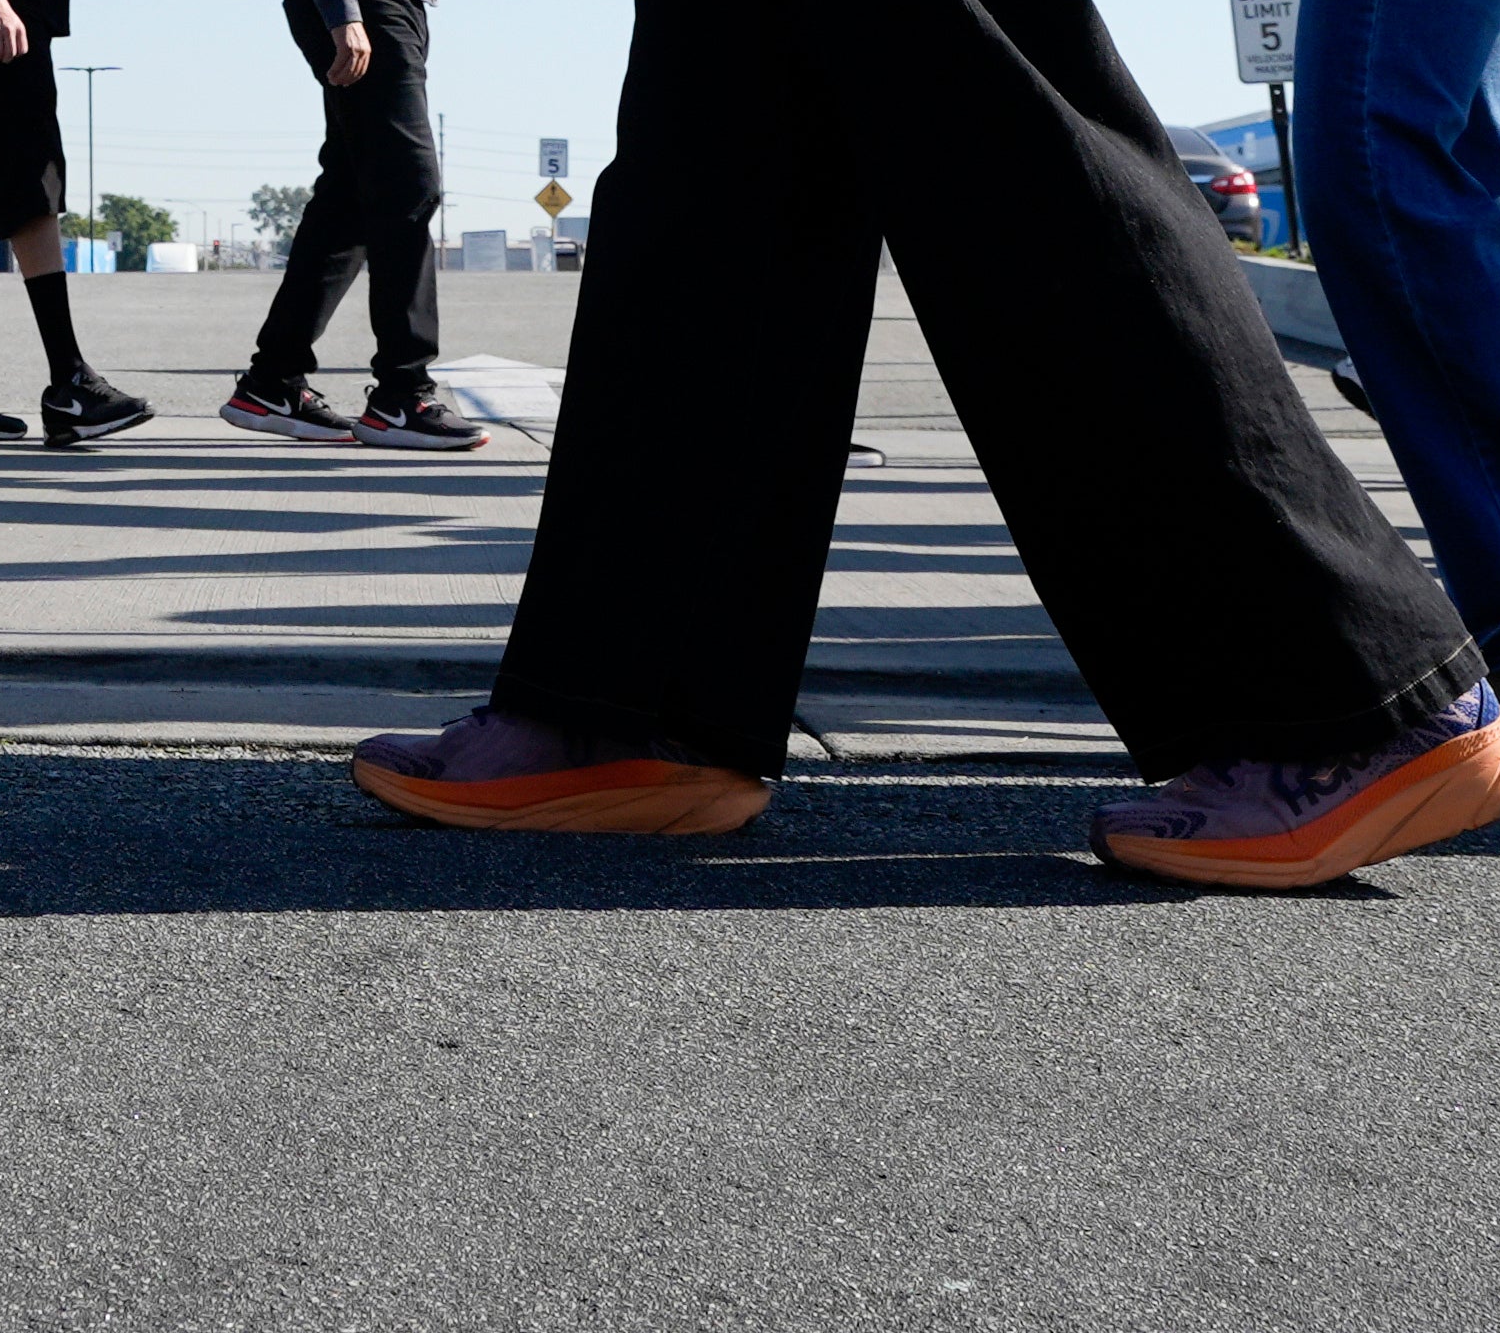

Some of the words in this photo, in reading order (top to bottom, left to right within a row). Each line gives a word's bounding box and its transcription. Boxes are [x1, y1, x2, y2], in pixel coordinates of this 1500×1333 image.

[1243, 2, 1293, 19] LIMIT
[1261, 23, 1282, 51] 5
[548, 158, 560, 174] 5
